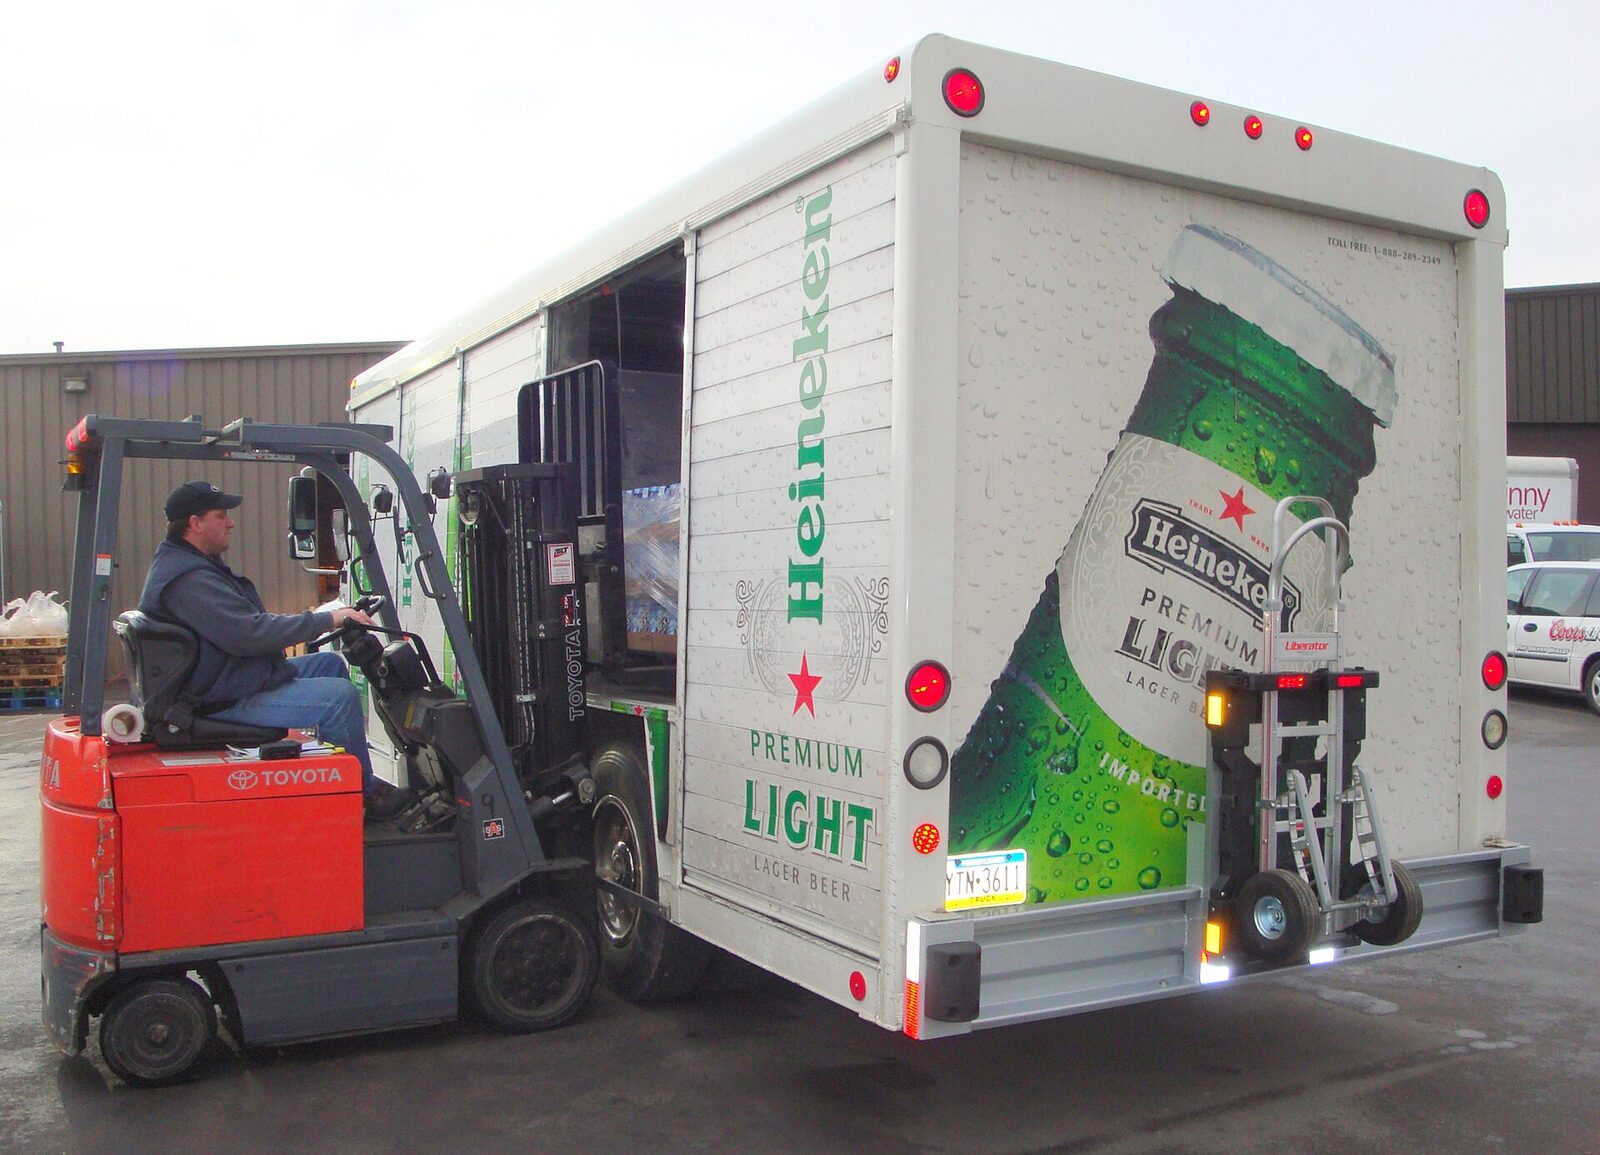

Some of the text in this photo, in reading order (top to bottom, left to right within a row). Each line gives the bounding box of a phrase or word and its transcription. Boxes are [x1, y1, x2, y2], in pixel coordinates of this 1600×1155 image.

[1327, 236, 1347, 248] TOLL
[787, 184, 833, 625] Heineken
[1188, 499, 1214, 516] TRADE
[1142, 515, 1269, 609] Heineke
[1250, 534, 1270, 553] MARK
[1140, 587, 1259, 667] PREMIUM
[1285, 641, 1329, 651] Liberator
[1549, 619, 1585, 642] Coors
[565, 629, 585, 721] TOYOTA
[1126, 670, 1179, 706] LAGER
[751, 729, 863, 778] PREMIUM
[262, 767, 342, 786] TOYOTA
[742, 779, 877, 870] LIGHT
[754, 854, 850, 902] LAGER BEER
